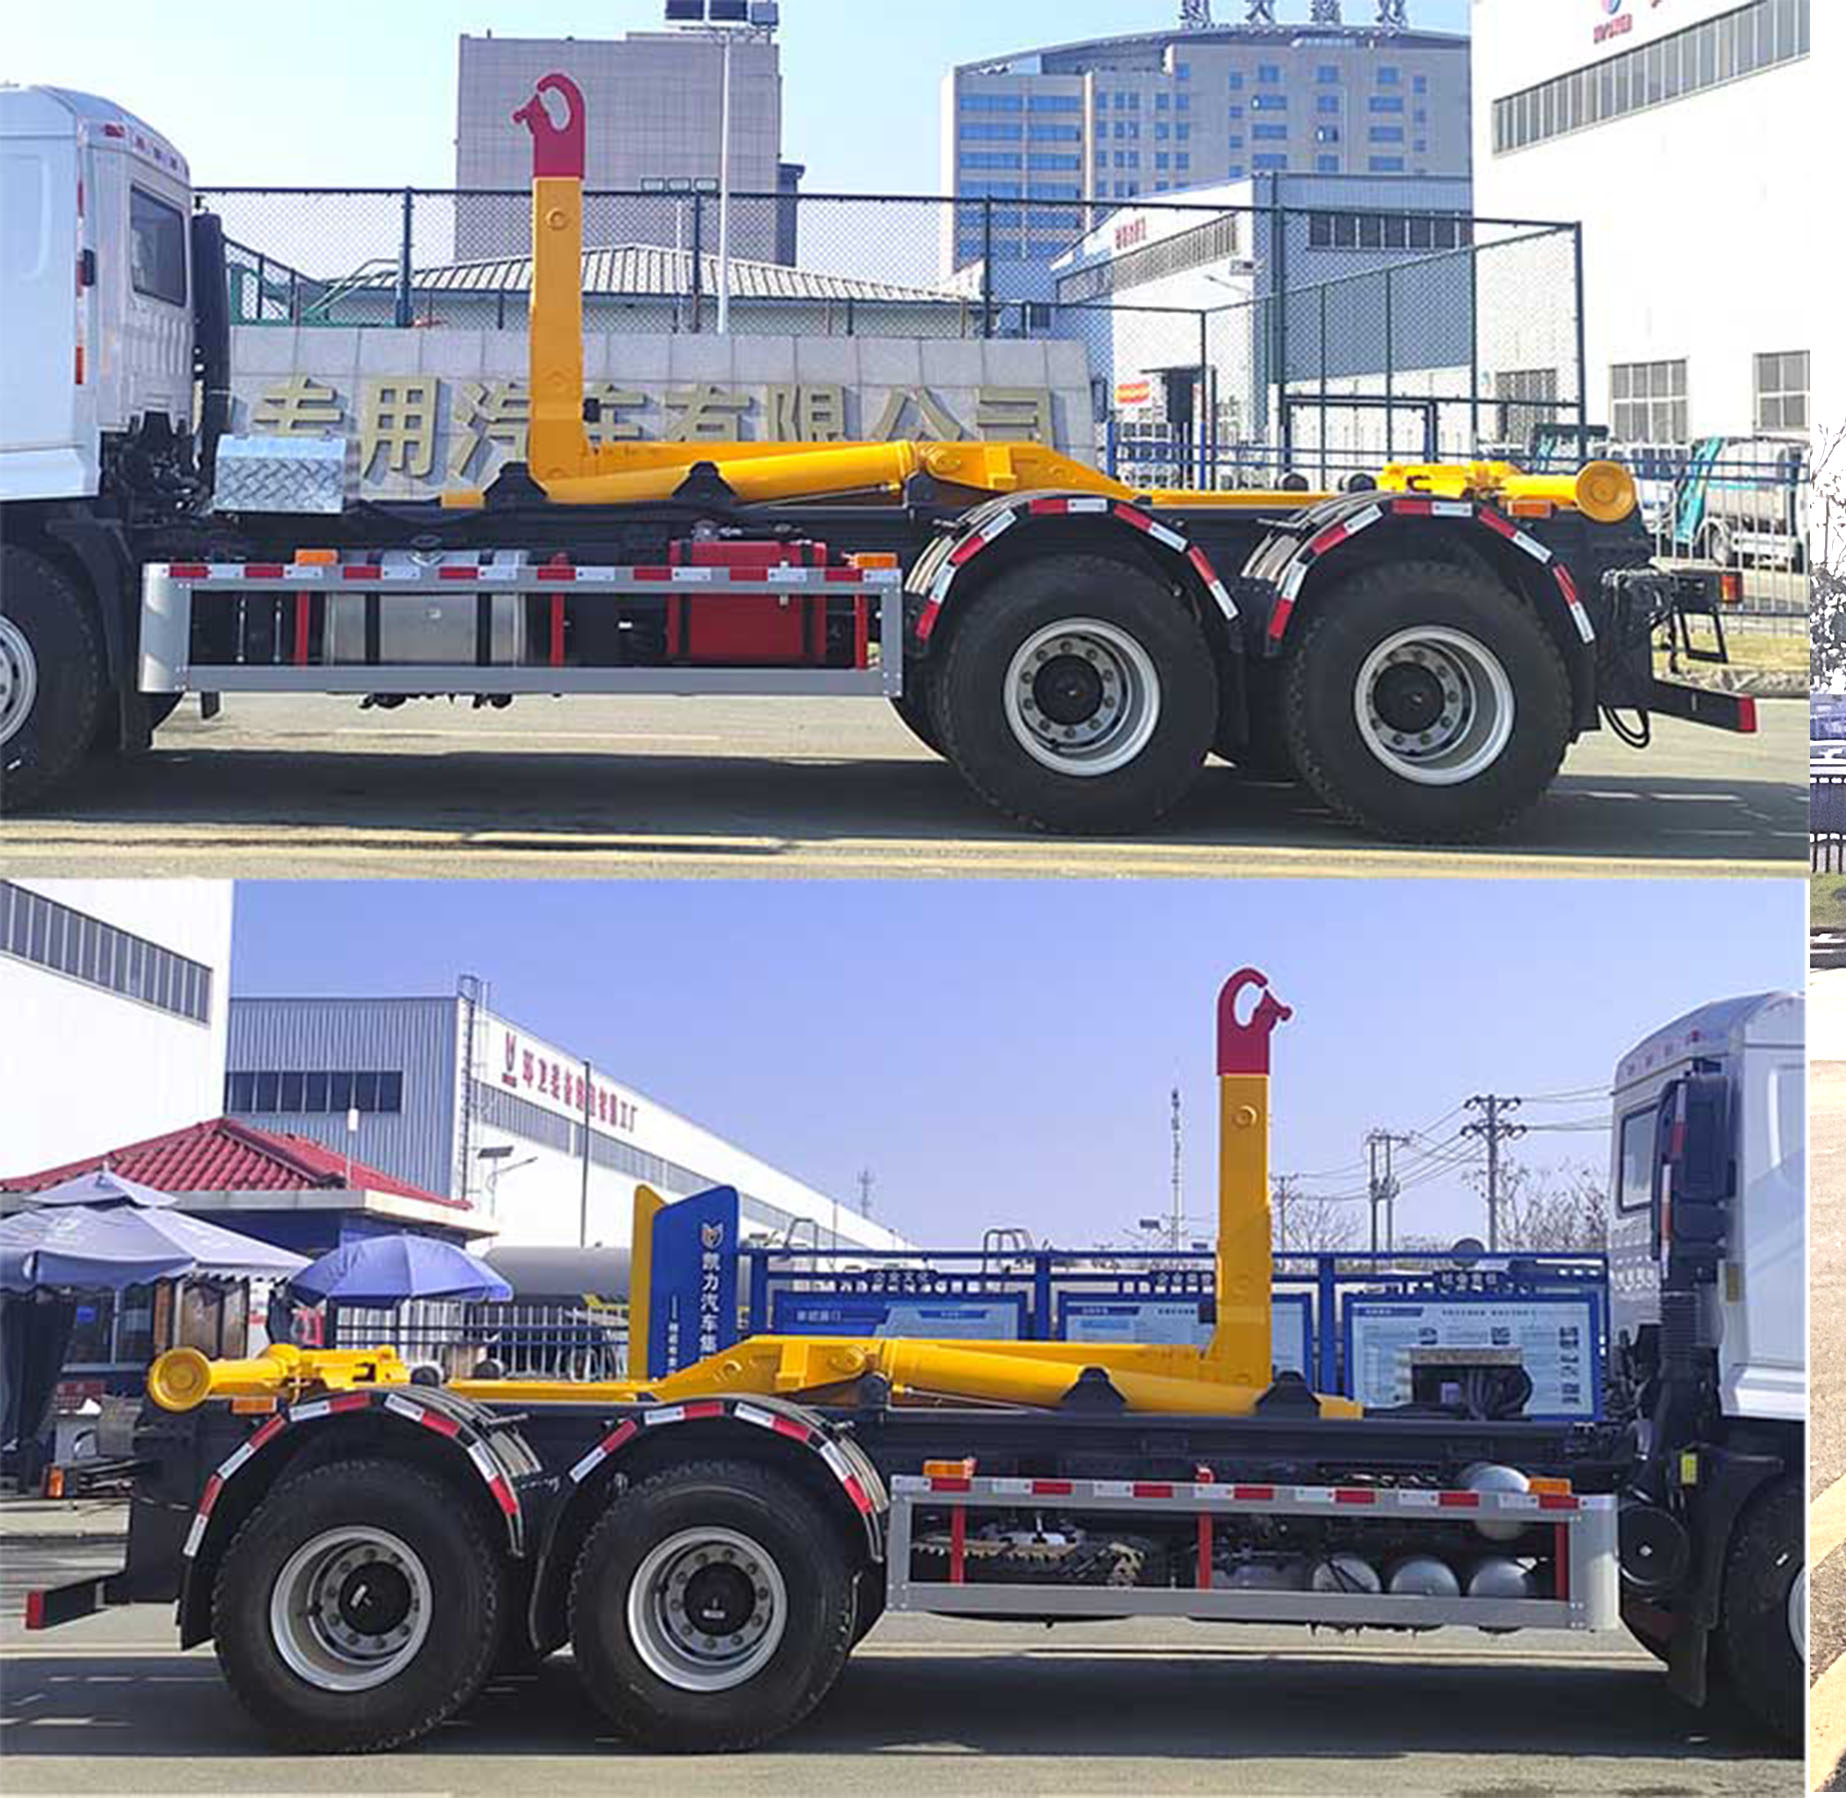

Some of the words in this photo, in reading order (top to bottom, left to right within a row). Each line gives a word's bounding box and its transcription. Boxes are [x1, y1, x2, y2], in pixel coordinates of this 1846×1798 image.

[700, 1252, 721, 1361] 凯力汽车集
